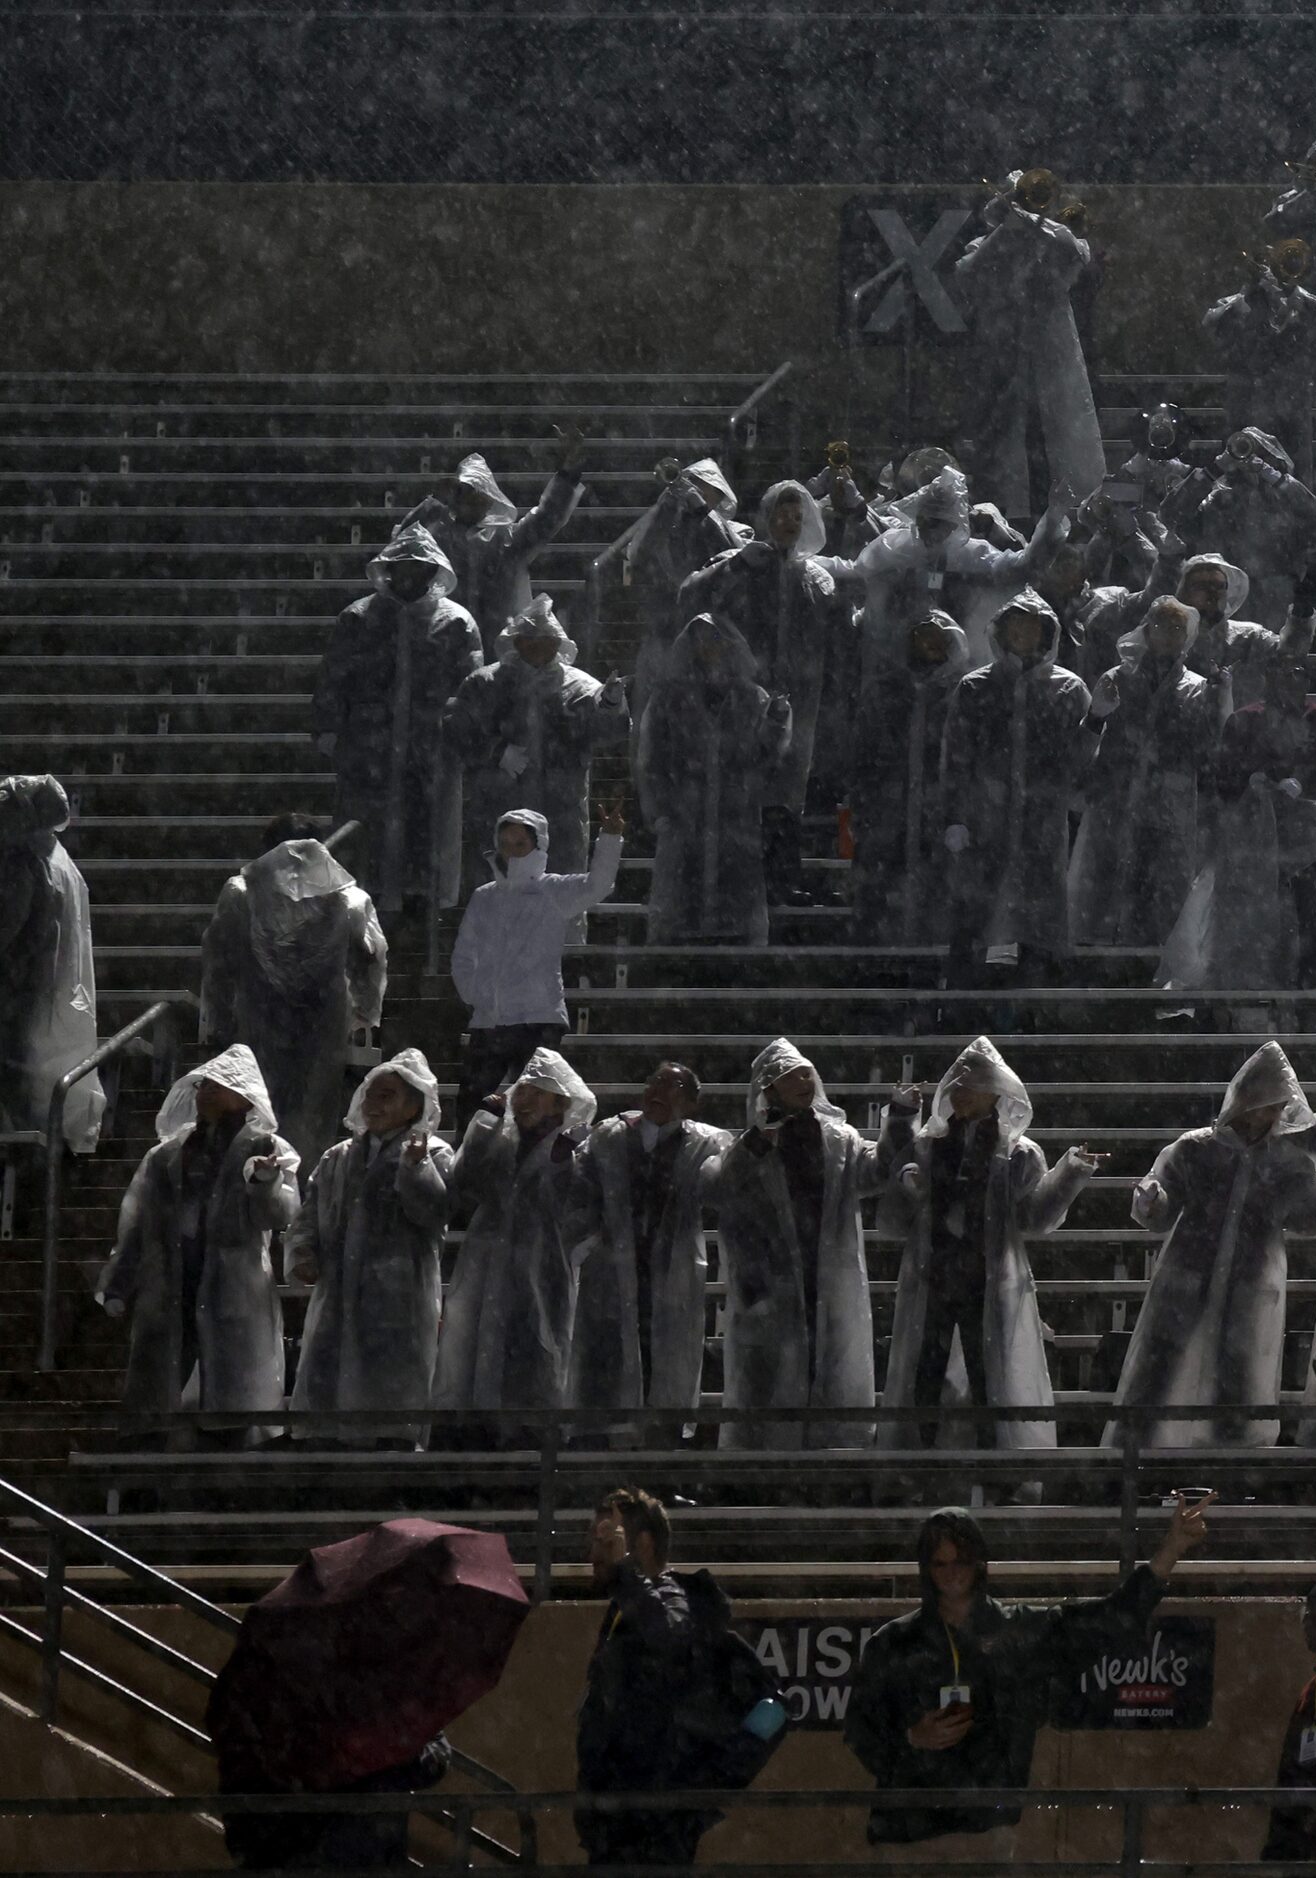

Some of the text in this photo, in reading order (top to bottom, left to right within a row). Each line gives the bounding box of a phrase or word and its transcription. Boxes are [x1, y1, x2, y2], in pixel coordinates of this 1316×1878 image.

[861, 209, 972, 332] X
[783, 1685, 852, 1721] OW
[1113, 1708, 1175, 1718] NEWKS.COM
